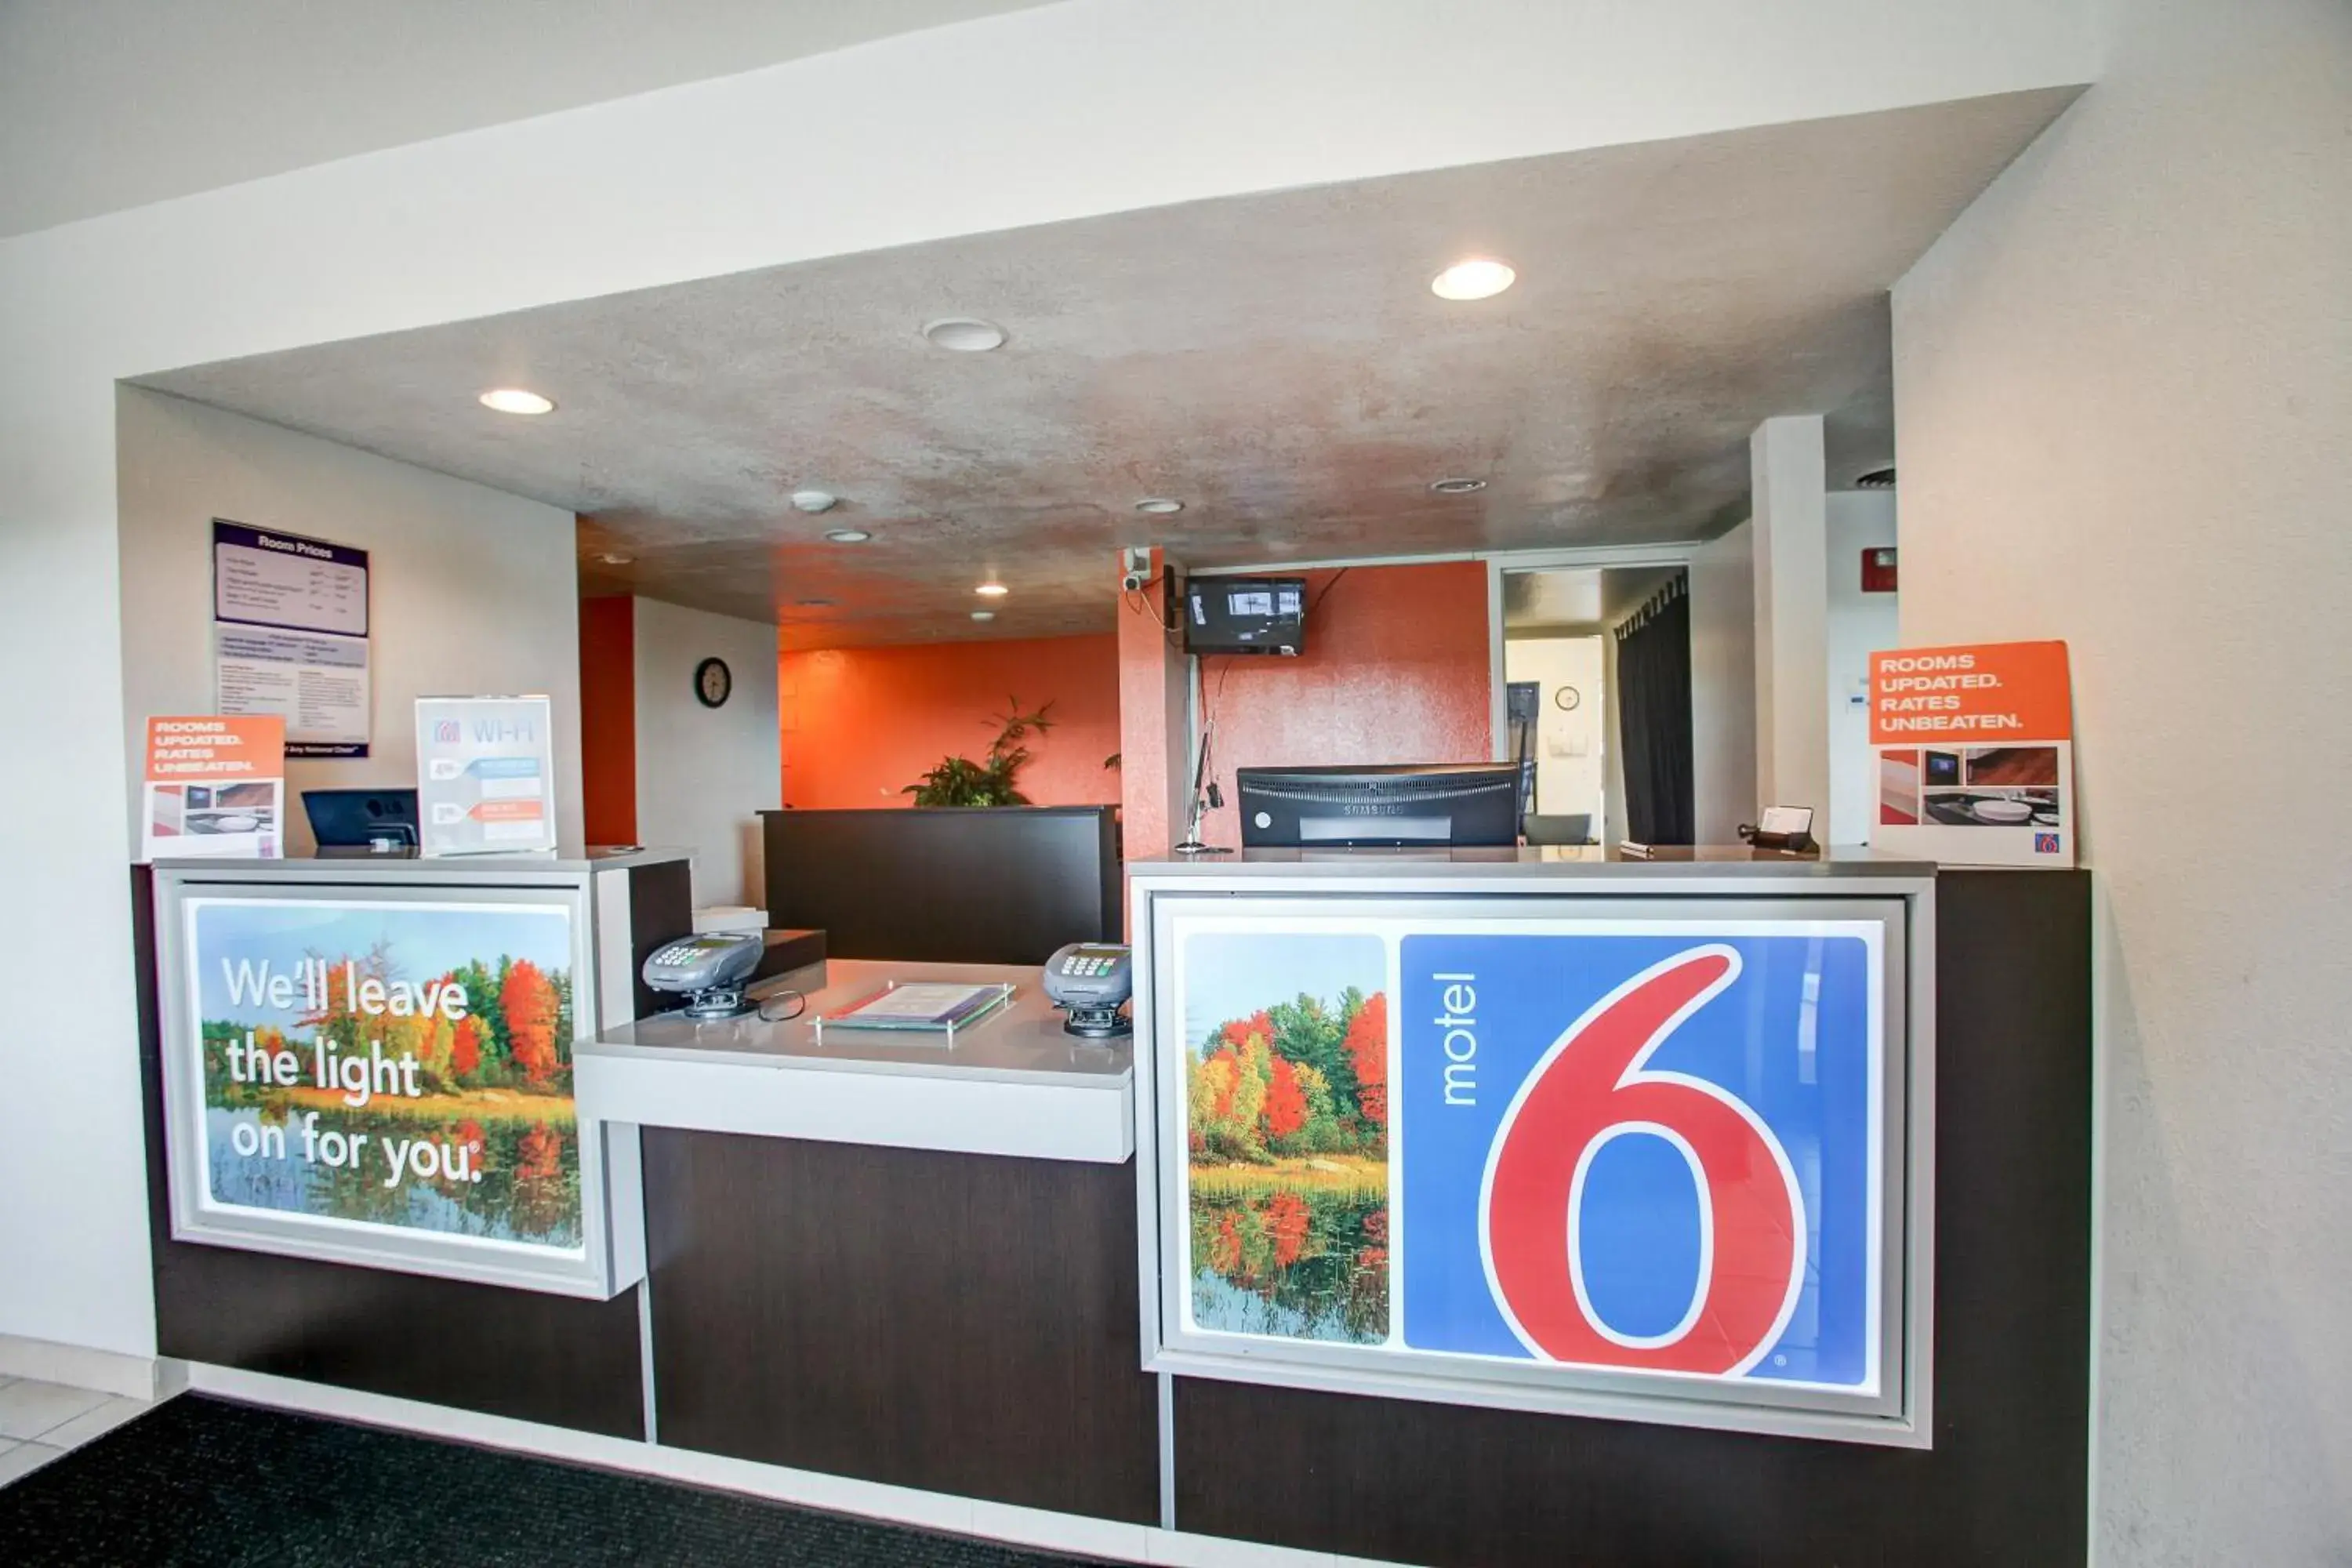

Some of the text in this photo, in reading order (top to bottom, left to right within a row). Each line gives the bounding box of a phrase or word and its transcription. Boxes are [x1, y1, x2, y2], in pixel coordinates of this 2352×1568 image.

[258, 535, 333, 559] Room Prices
[1881, 655, 1975, 673] ROOMS
[1880, 673, 2002, 692] UPDATED.
[1881, 695, 1961, 712] RATES
[155, 722, 225, 732] ROOMS
[1880, 713, 2024, 731] UNBEATEN.
[154, 735, 243, 745] UPDATED.
[154, 749, 214, 759] RATES
[221, 956, 469, 1020] We'll leave
[1432, 972, 1476, 1106] motel
[225, 1031, 421, 1107] the light
[231, 1121, 285, 1160] on
[300, 1111, 368, 1169] for
[1478, 942, 1807, 1378] 6
